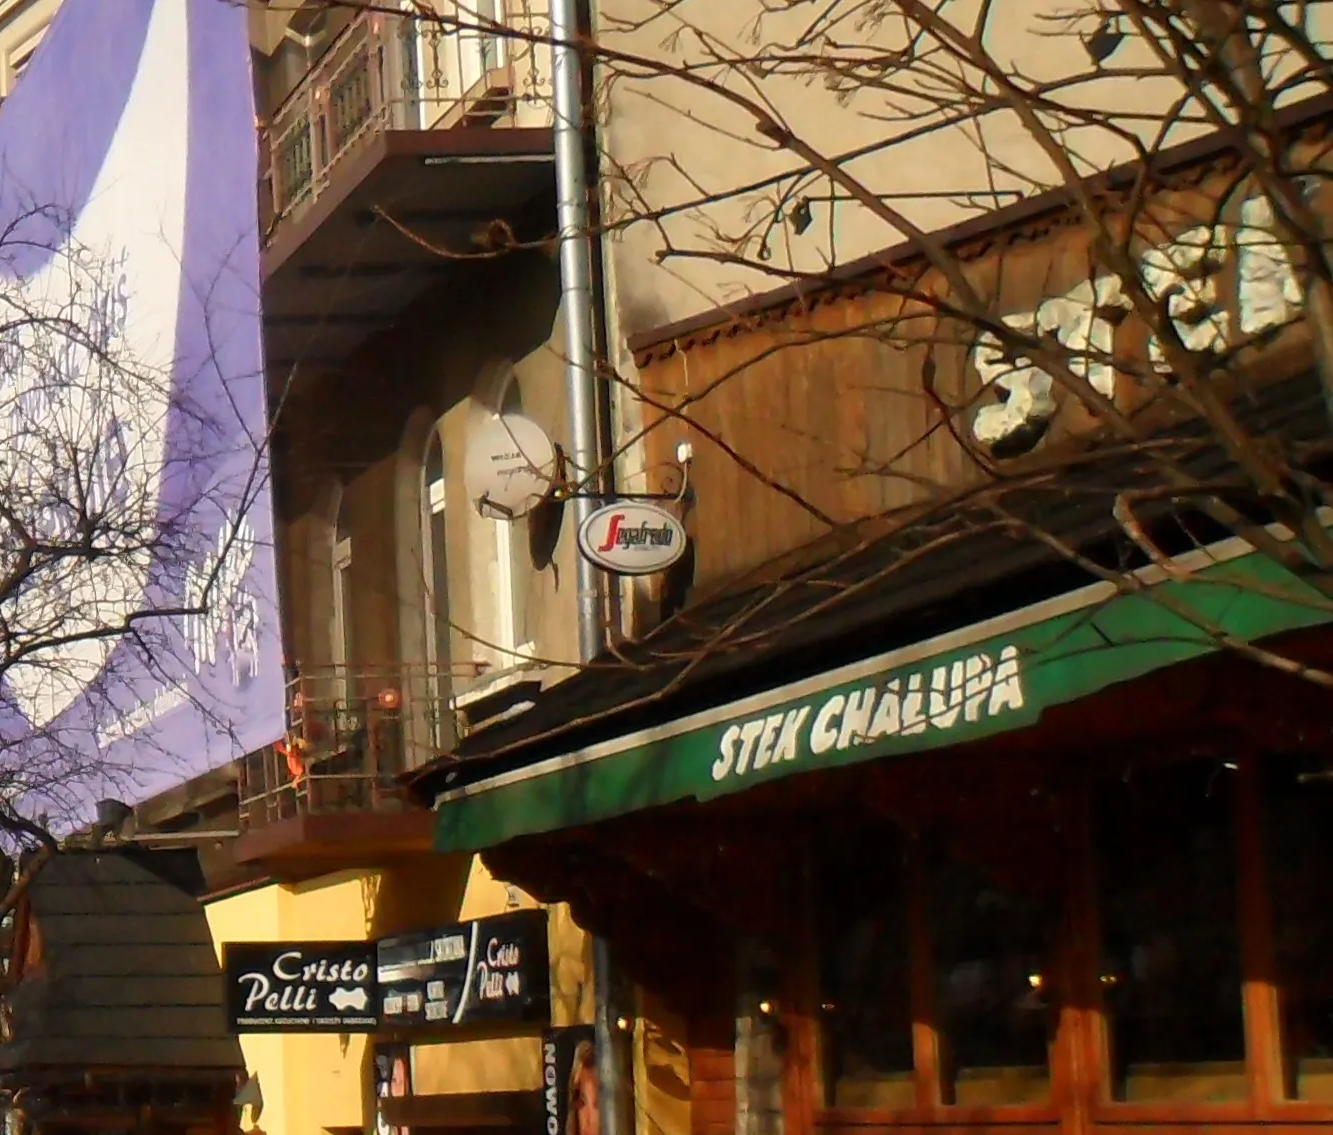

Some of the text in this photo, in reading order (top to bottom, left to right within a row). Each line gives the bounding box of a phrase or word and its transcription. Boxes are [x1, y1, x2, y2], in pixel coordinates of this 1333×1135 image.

[711, 705, 811, 781] STEK
[272, 951, 369, 982] Cristo
[237, 972, 318, 1012] Pelli
